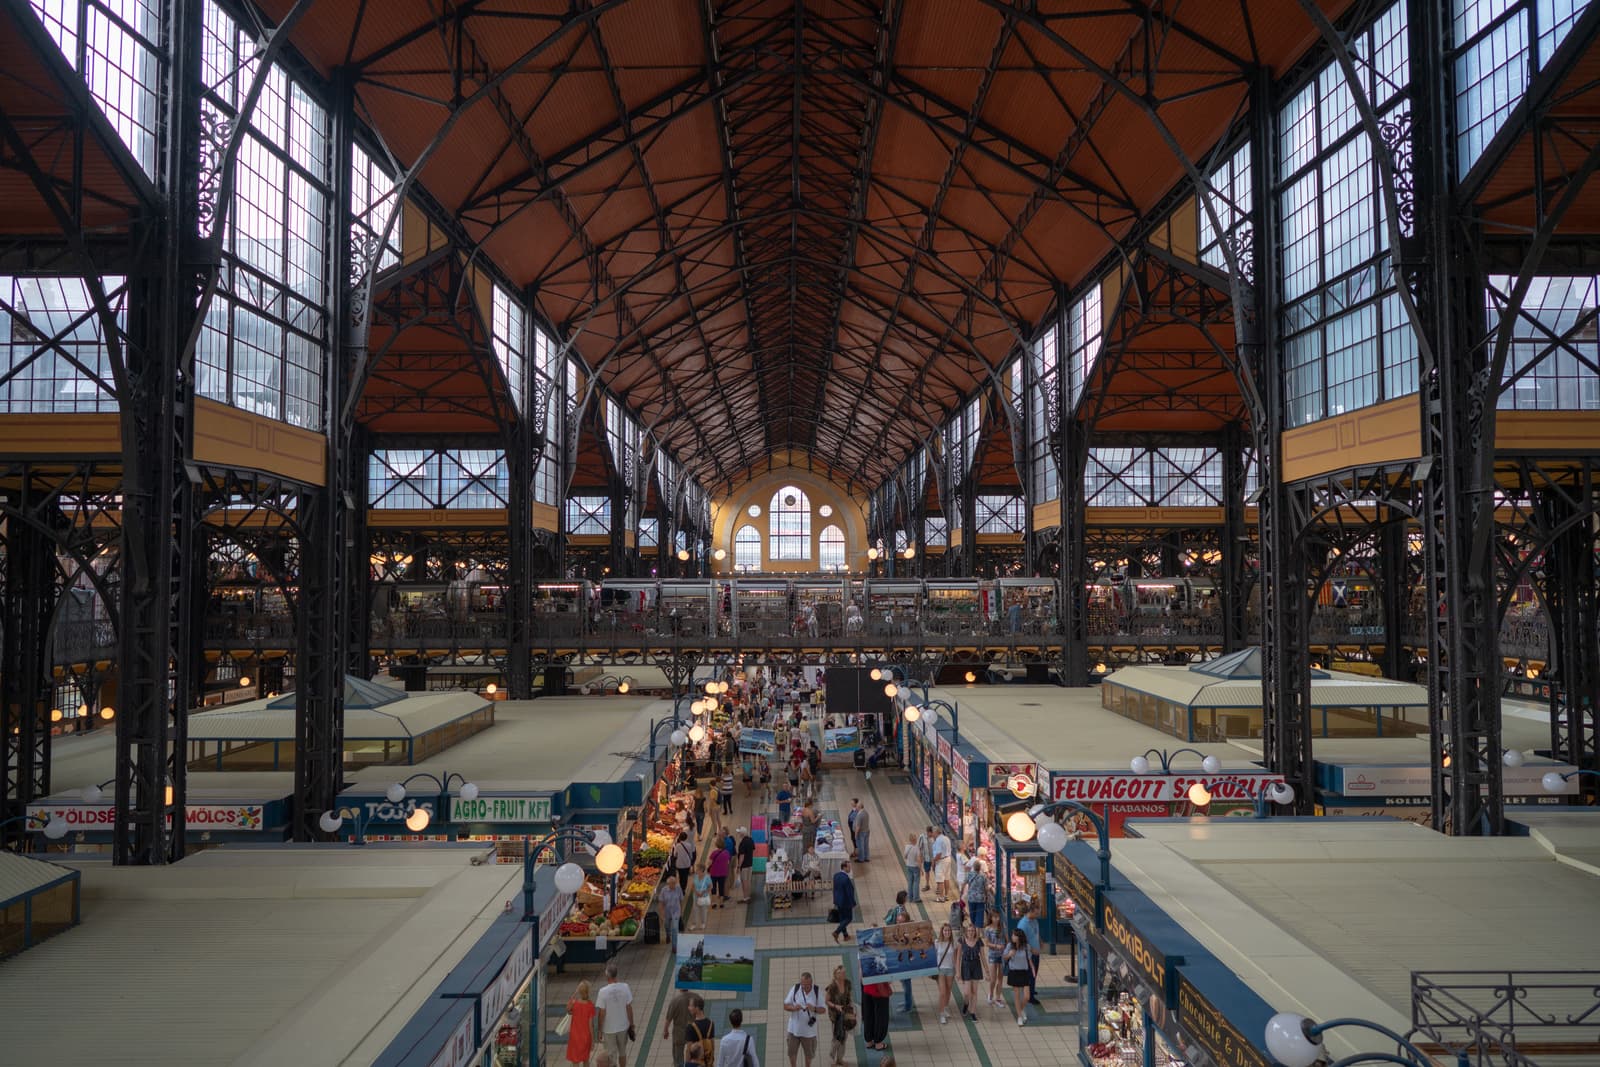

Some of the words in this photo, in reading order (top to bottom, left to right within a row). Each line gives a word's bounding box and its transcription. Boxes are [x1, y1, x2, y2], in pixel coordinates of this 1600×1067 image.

[1055, 776, 1166, 800] FELVÁGOTT
[54, 806, 117, 824] ÖLDSÉ
[454, 799, 525, 820] AGRO-FRUIT
[528, 800, 550, 819] KFT.
[1112, 804, 1165, 813] KABANOS
[1180, 989, 1221, 1044] Chocolate
[1225, 1036, 1232, 1055] &
